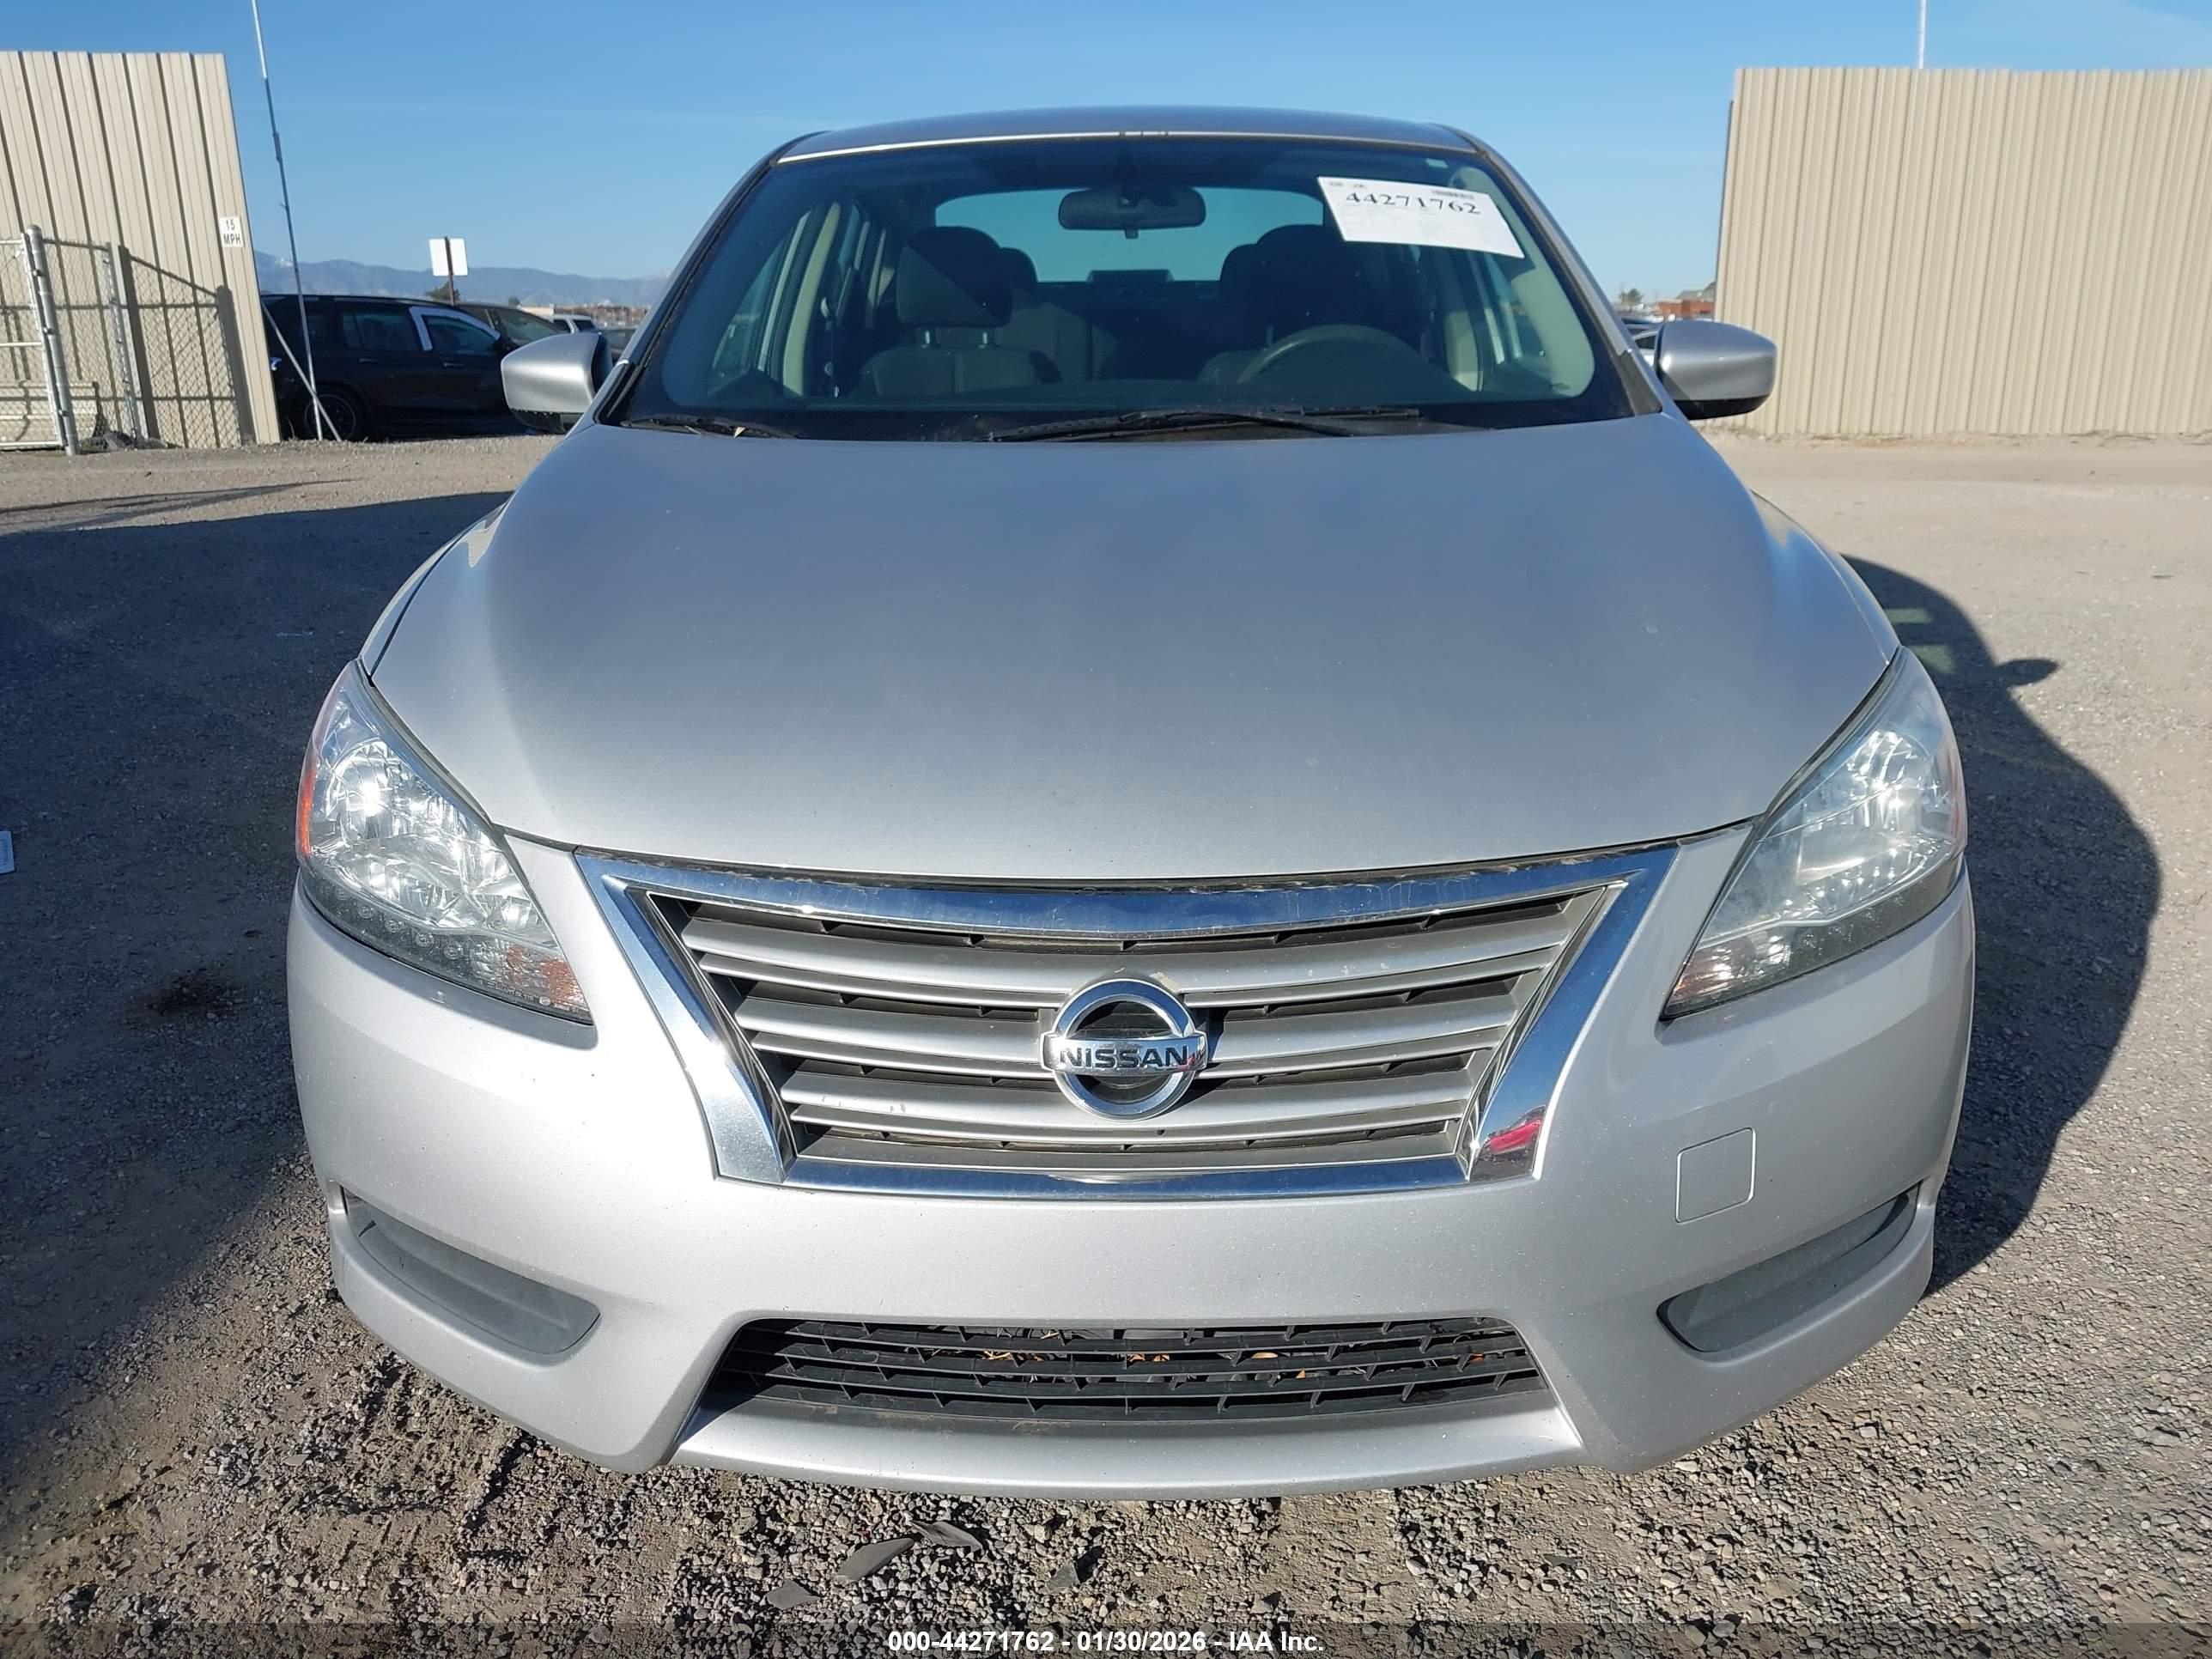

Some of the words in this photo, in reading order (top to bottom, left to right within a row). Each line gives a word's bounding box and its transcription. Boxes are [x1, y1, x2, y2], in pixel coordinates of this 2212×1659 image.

[1346, 191, 1481, 216] 44271762
[226, 219, 235, 231] 15
[223, 234, 241, 245] MPH
[1059, 1045, 1188, 1069] NISSAN
